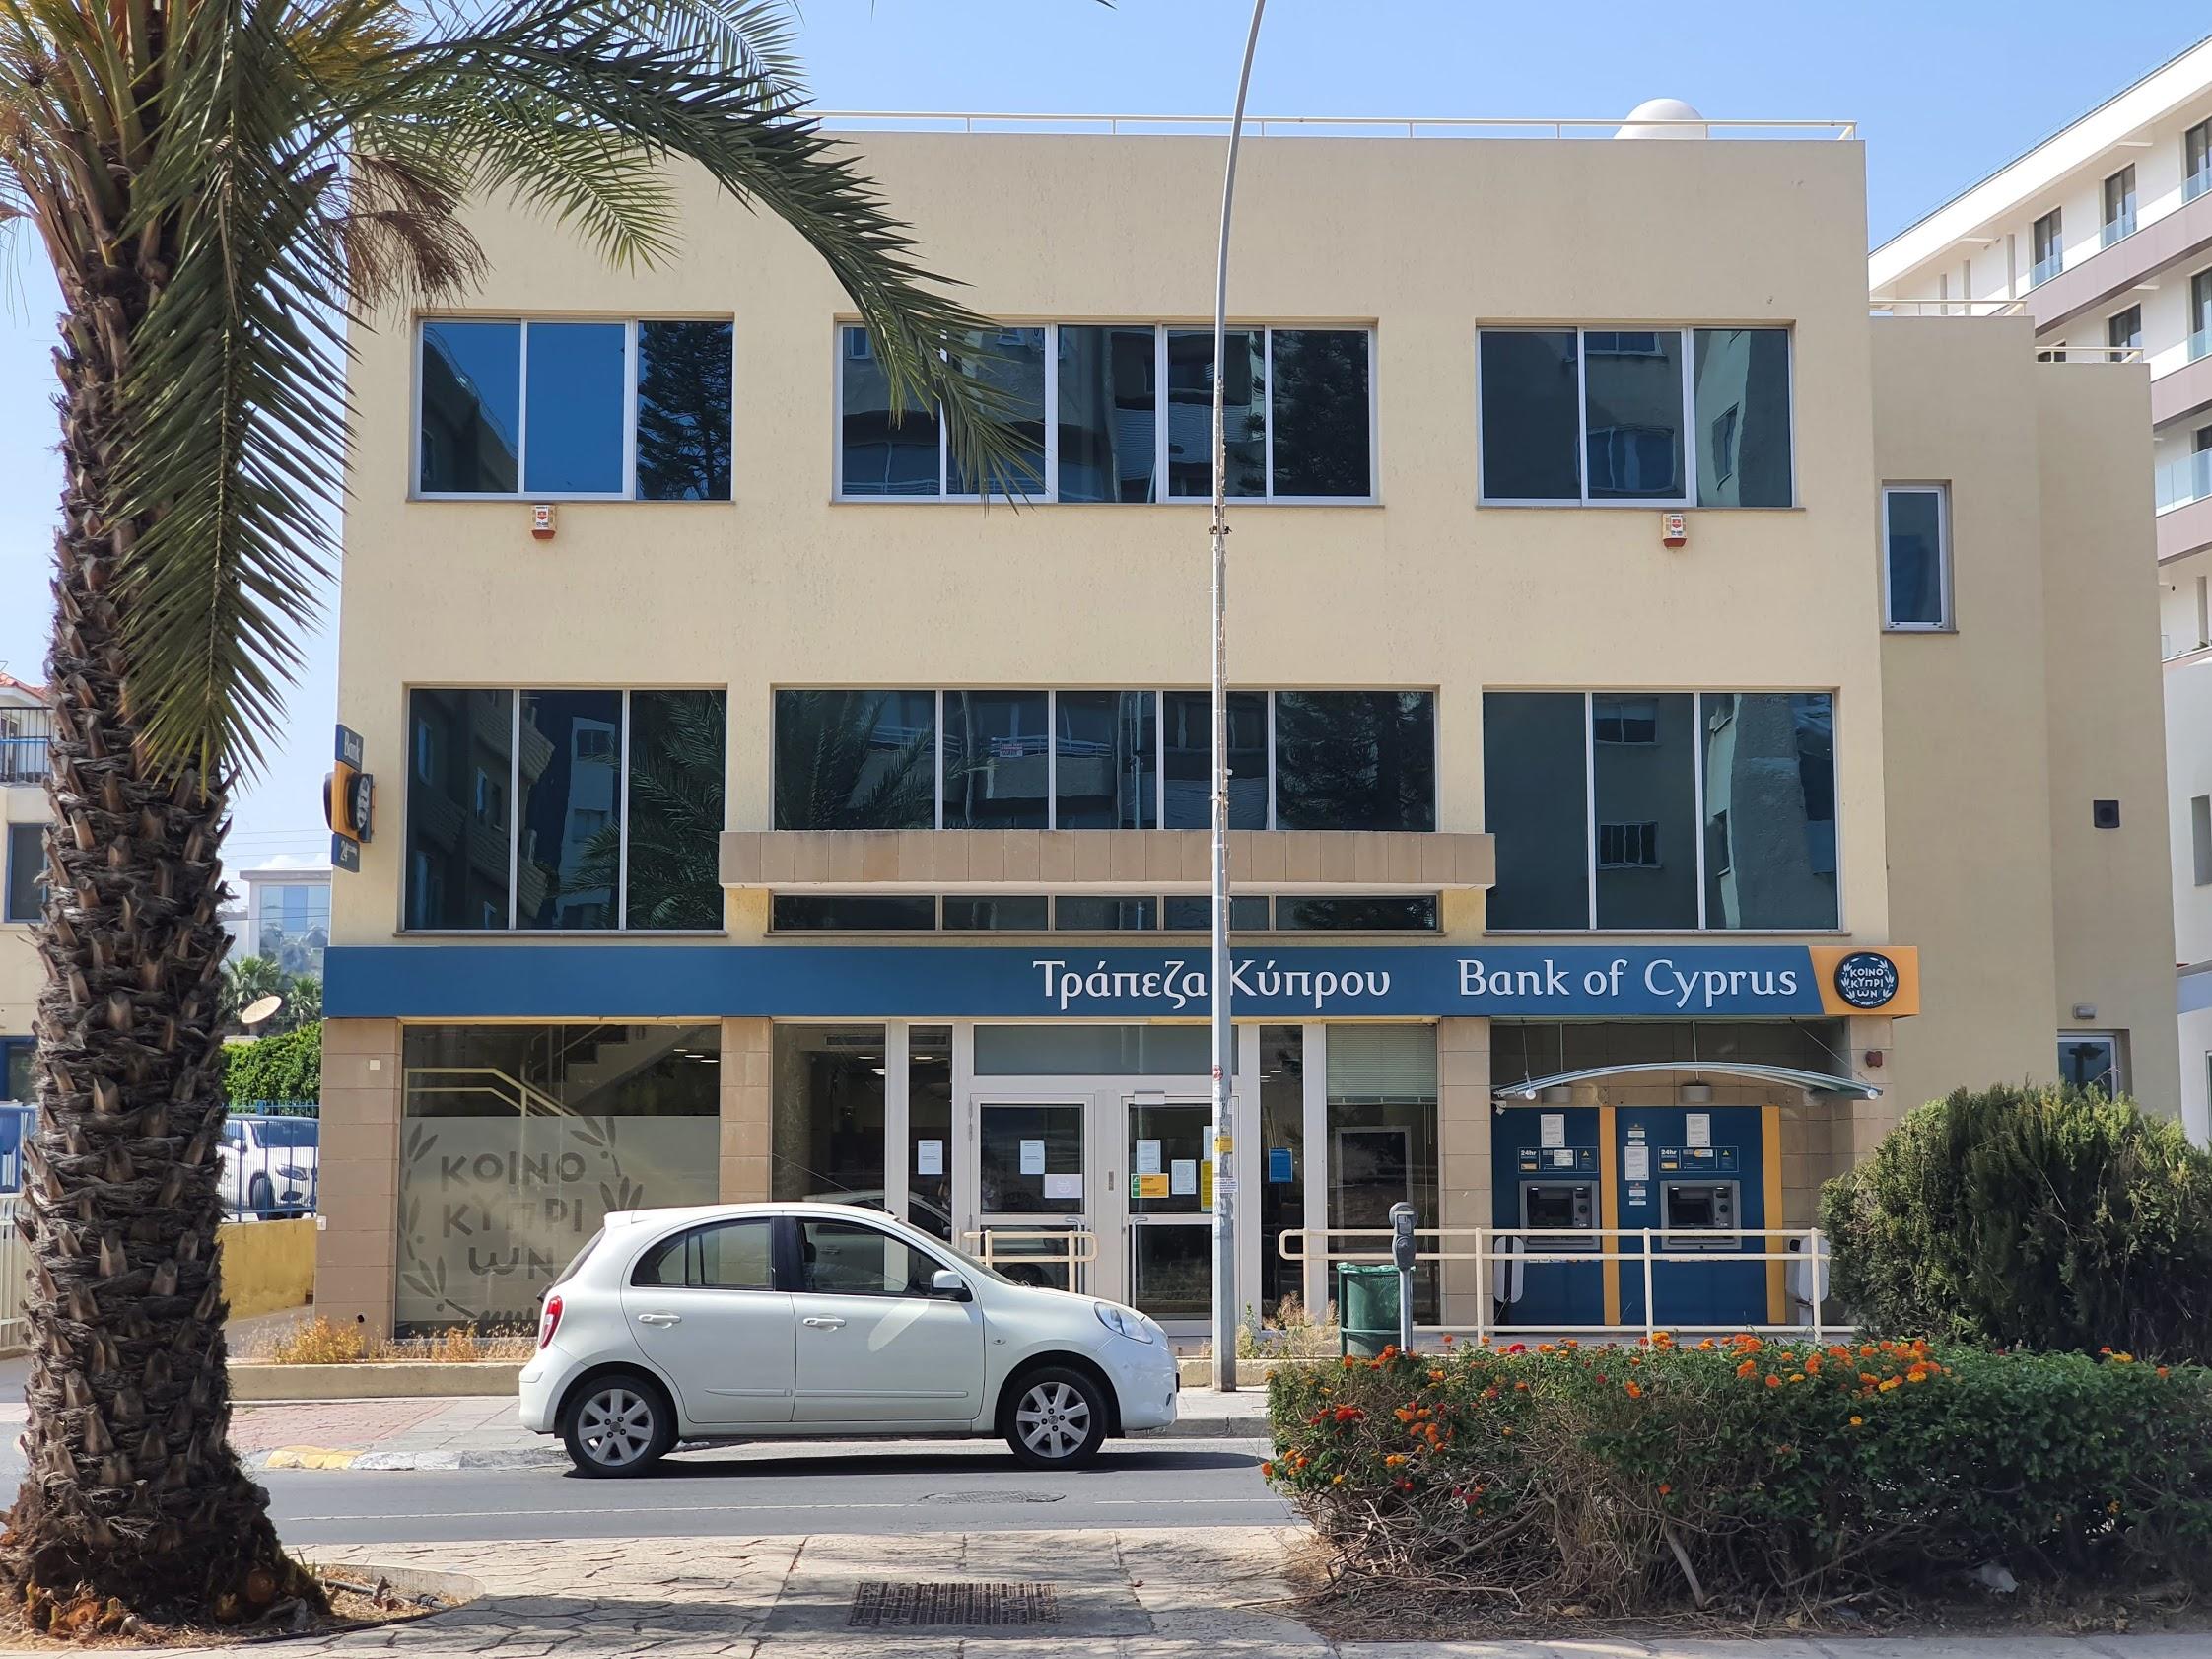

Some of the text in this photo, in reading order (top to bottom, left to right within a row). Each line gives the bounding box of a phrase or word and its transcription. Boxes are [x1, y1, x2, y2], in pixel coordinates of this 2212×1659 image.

[344, 731, 361, 764] Bank
[1032, 958, 1391, 1010] Τράπεζα Κύπρου
[1457, 959, 1798, 1009] Bank of Cyprus
